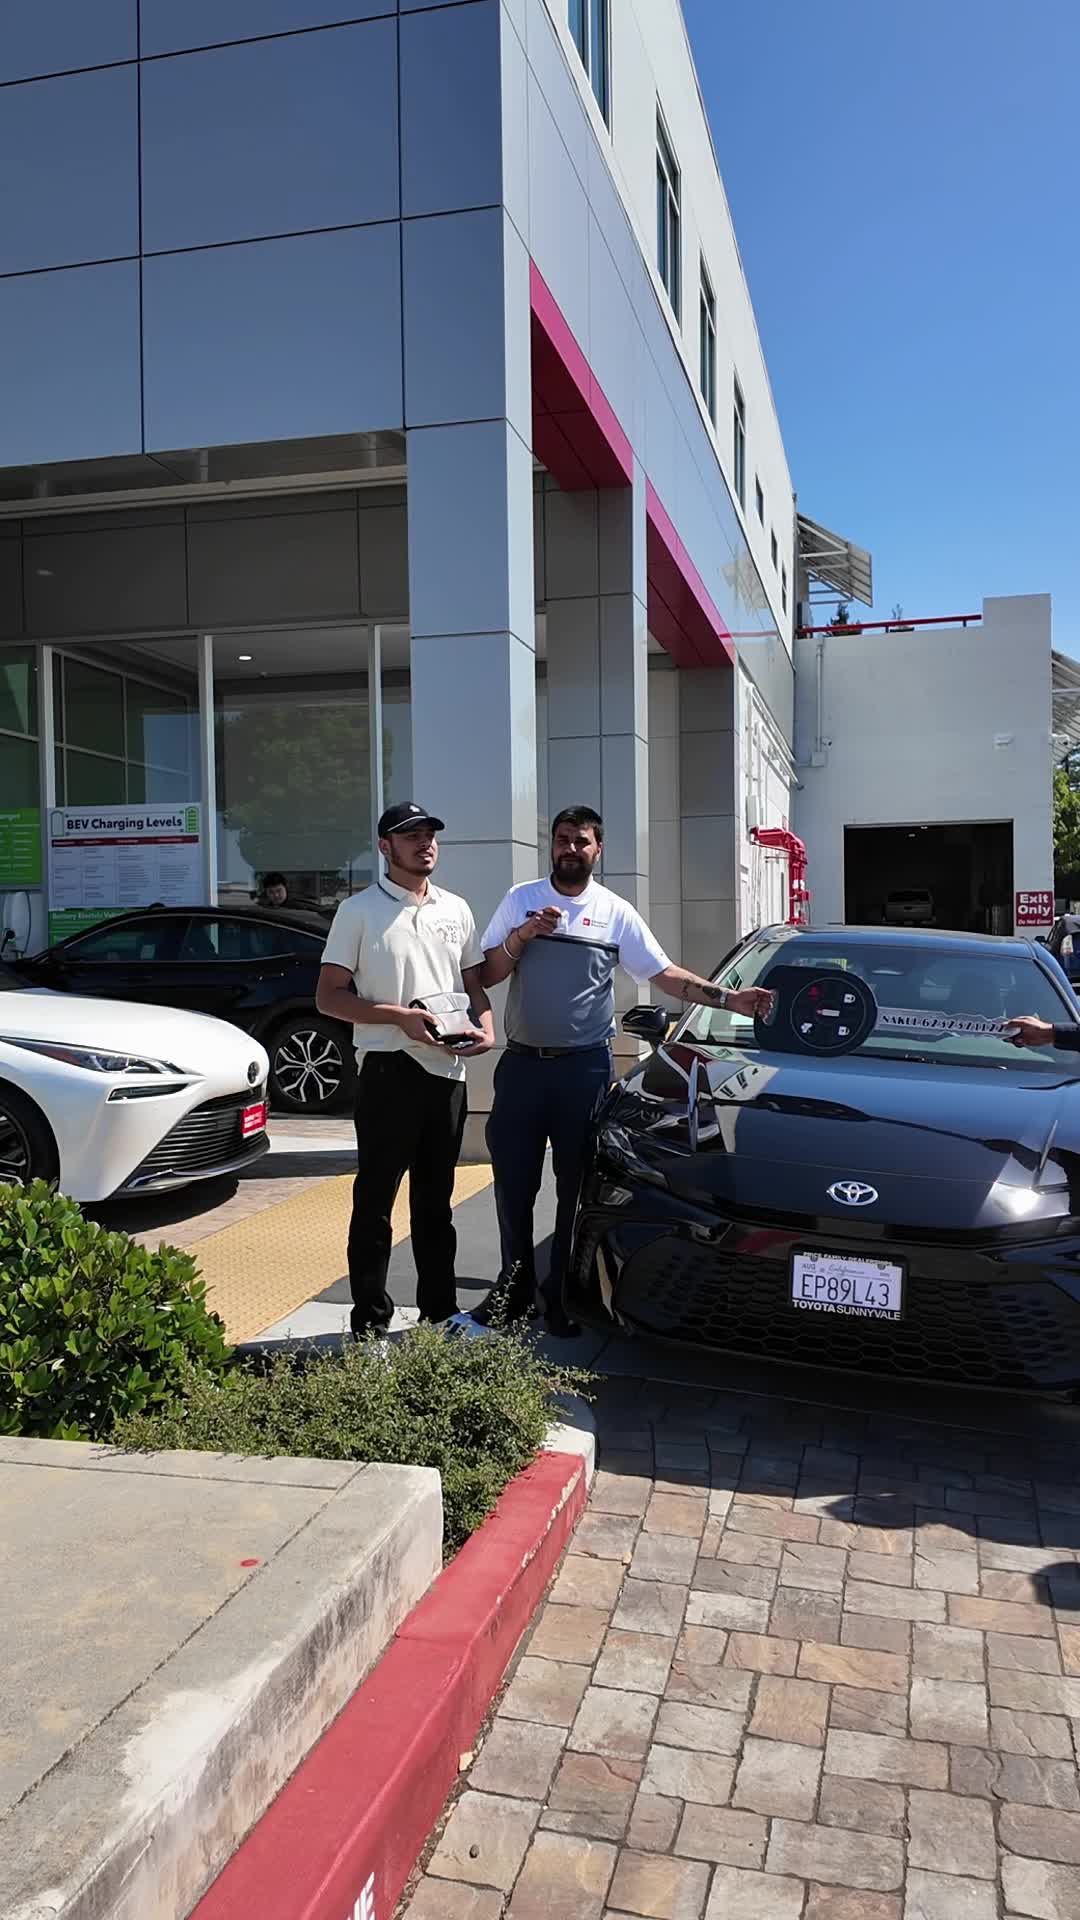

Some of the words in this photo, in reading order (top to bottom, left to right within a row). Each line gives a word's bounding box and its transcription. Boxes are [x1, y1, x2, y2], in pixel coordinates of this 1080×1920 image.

[66, 819, 89, 830] BEV
[91, 817, 144, 830] Charging
[146, 816, 183, 828] Levels
[1020, 894, 1049, 903] Exit
[1018, 905, 1051, 916] Only
[802, 1273, 890, 1307] EP89L43
[792, 1299, 836, 1313] TOYOTA
[836, 1304, 901, 1321] SUNNYVALE
